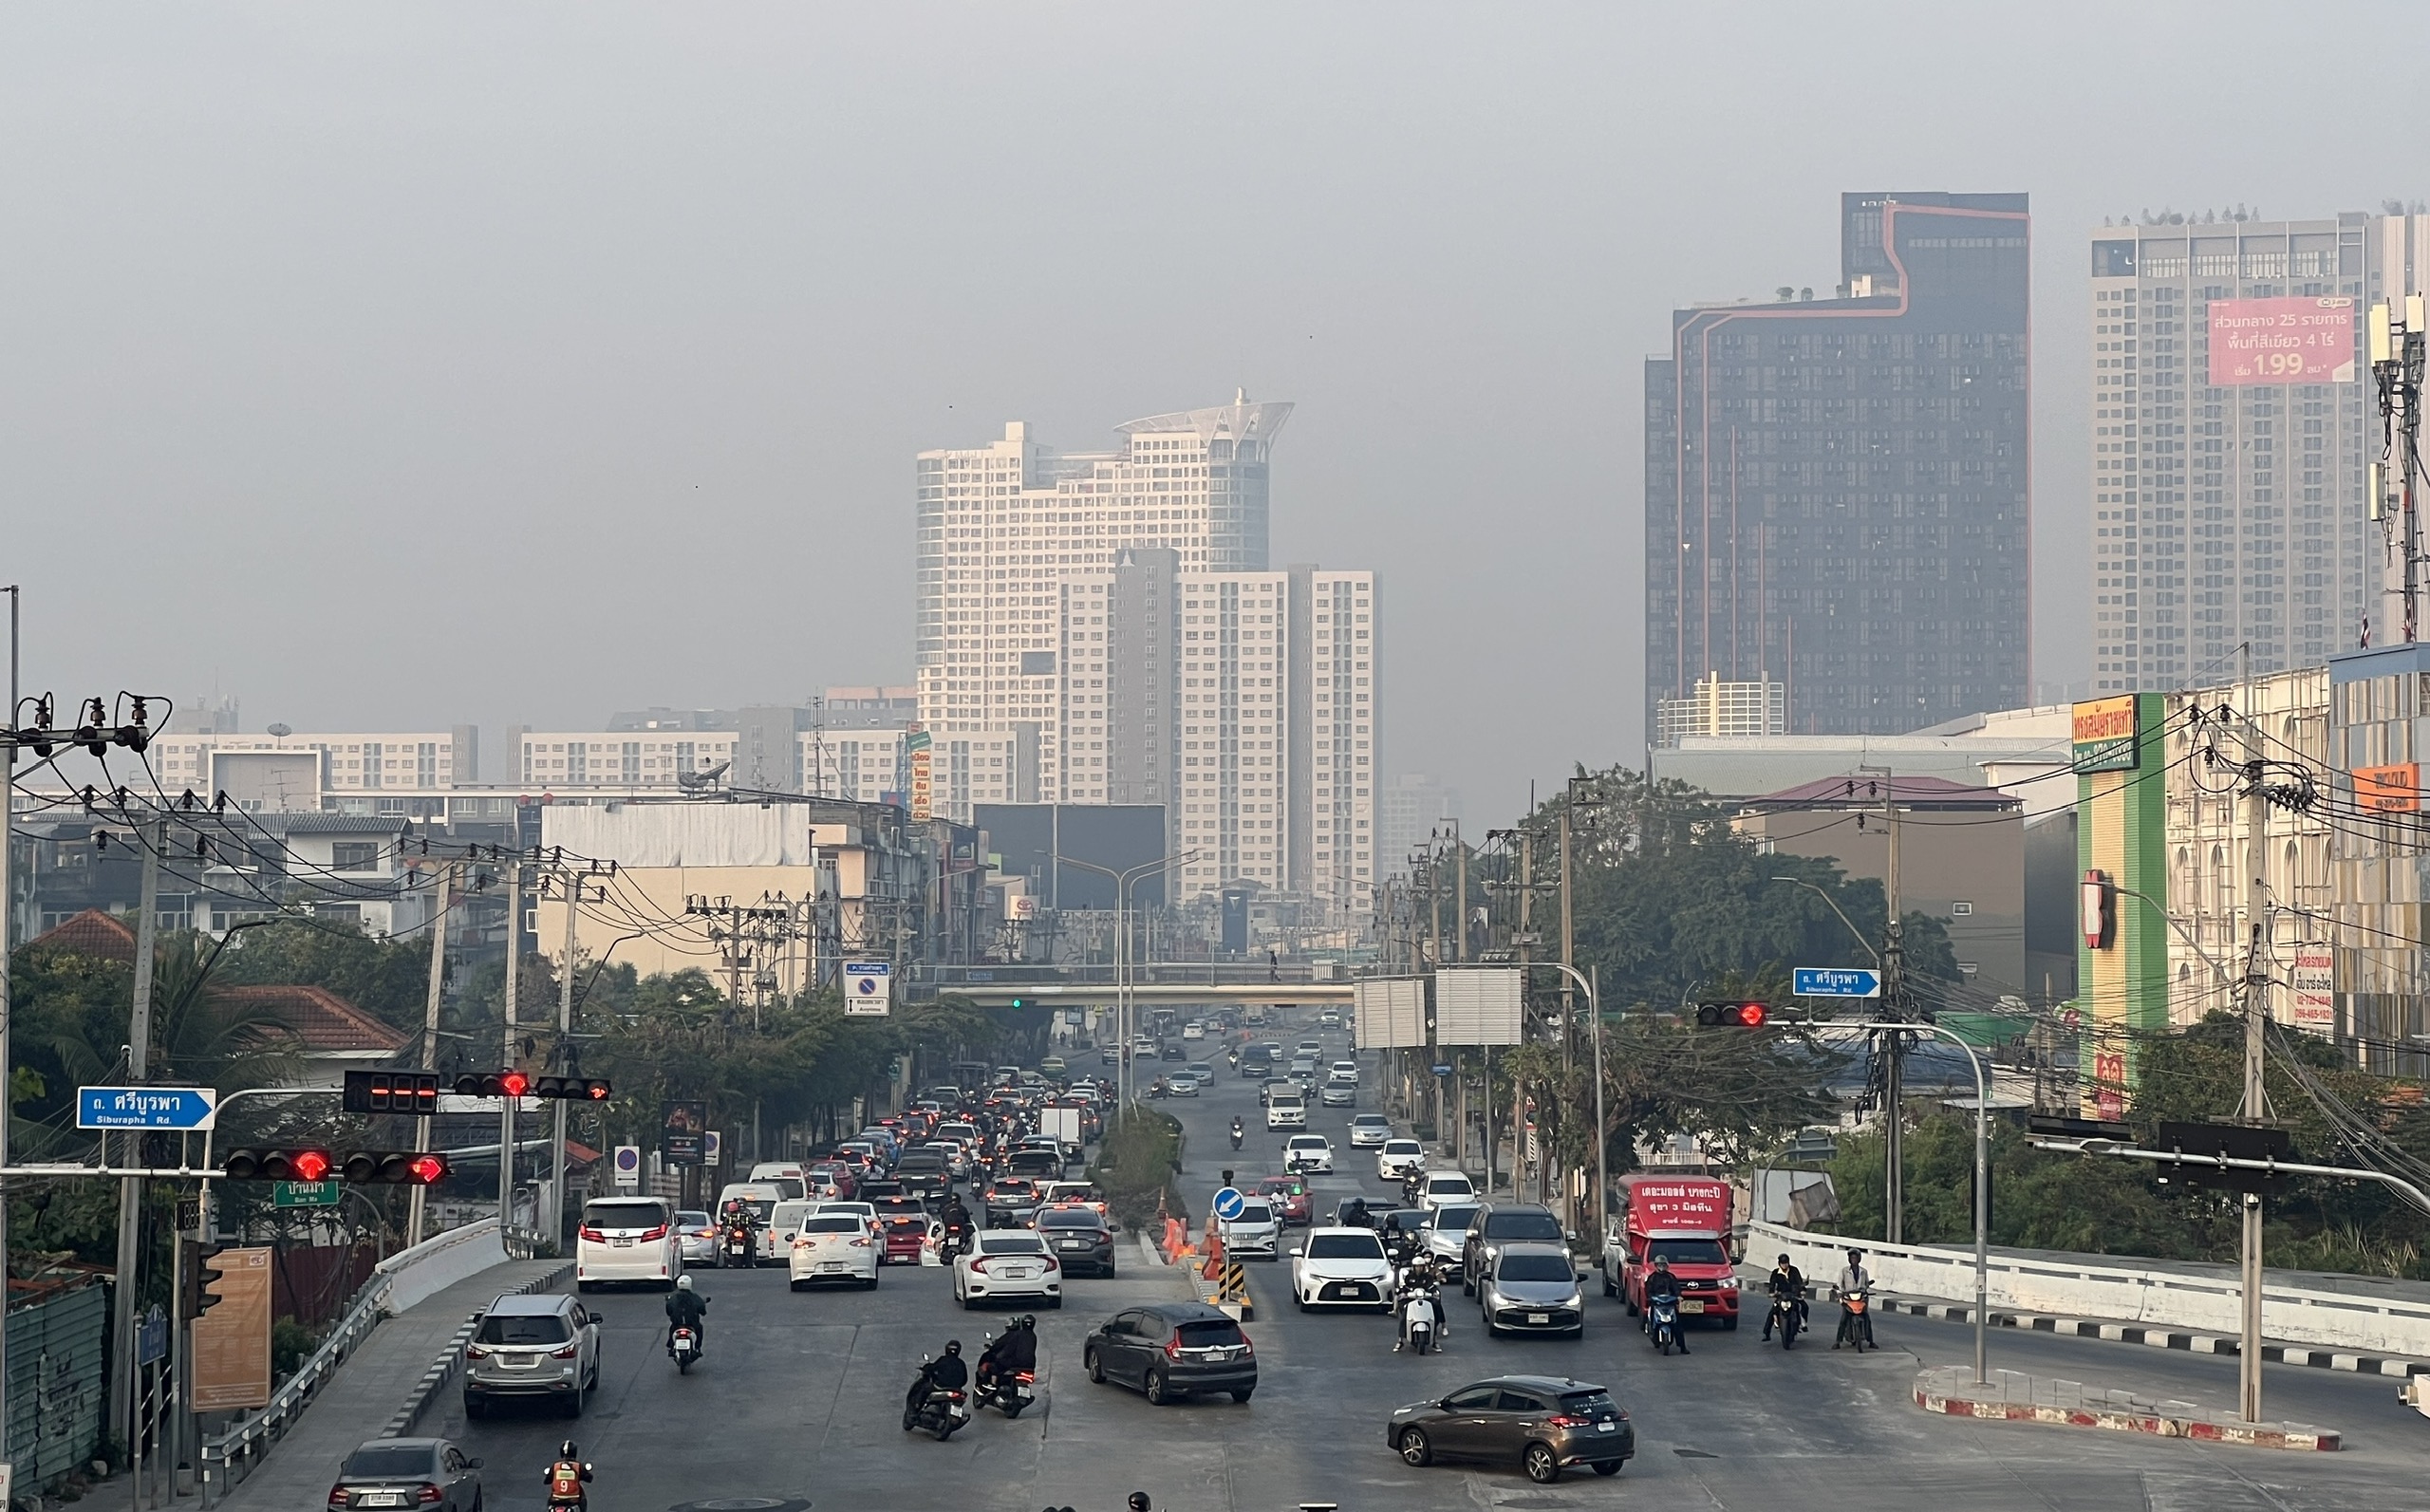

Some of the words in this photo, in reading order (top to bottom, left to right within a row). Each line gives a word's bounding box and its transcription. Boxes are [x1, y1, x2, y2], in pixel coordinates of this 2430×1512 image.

[2215, 314, 2274, 328] ส่วนกลาง
[2279, 313, 2296, 327] 25
[2301, 313, 2347, 327] รายการ
[2228, 330, 2301, 349] พื้นที่สีเขียว
[2306, 333, 2316, 347] 4
[2321, 331, 2335, 346] ไร่
[2253, 352, 2304, 376] 1.99
[1816, 971, 1859, 988] ศรีบูรพา
[93, 1098, 105, 1110] ถ.
[115, 1091, 180, 1115] ศรีบูรพา
[96, 1115, 146, 1126] Siburapha
[156, 1116, 172, 1125] Rd.
[1641, 1185, 1685, 1197] เดอะมอลล์
[1688, 1185, 1721, 1199] บางกะปิ
[560, 1481, 569, 1493] 9
